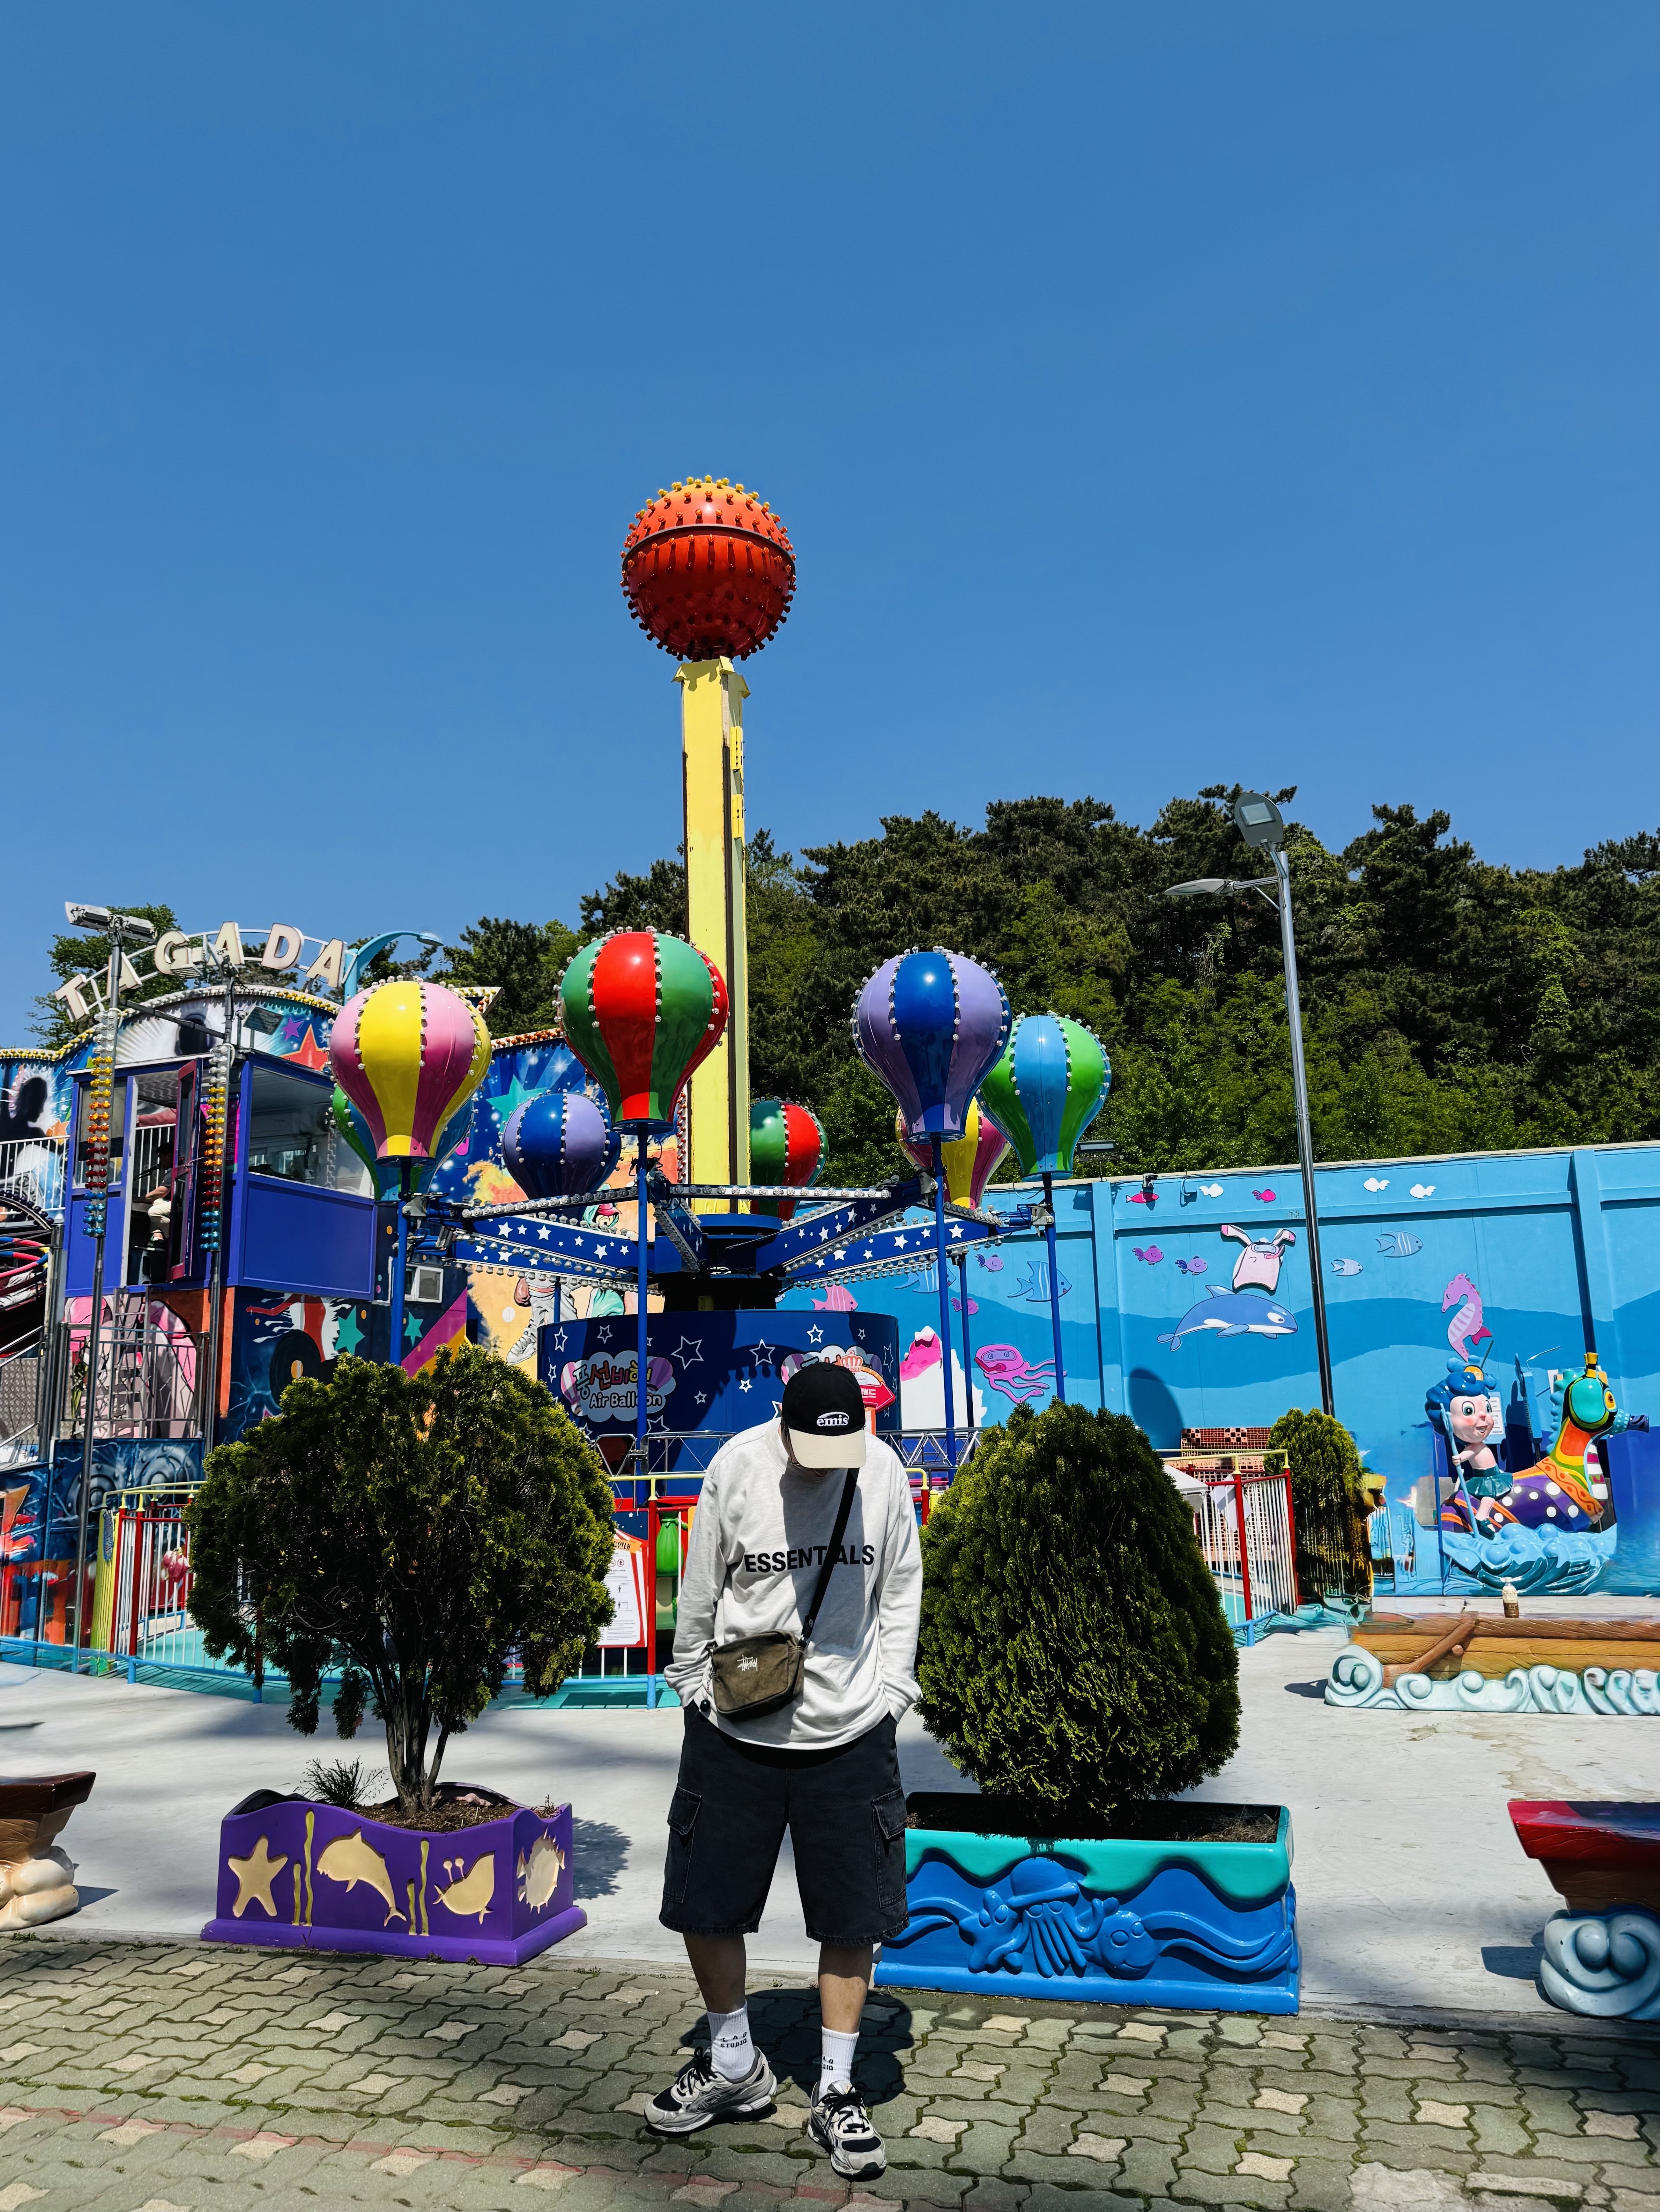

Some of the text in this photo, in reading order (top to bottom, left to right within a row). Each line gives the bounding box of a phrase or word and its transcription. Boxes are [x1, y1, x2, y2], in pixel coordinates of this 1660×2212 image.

[55, 921, 345, 1021] TAGADA
[590, 1392, 662, 1408] Air Ballon
[817, 1414, 848, 1427] emis
[744, 1545, 875, 1573] ESSENTALS
[721, 2038, 747, 2048] STUDIO
